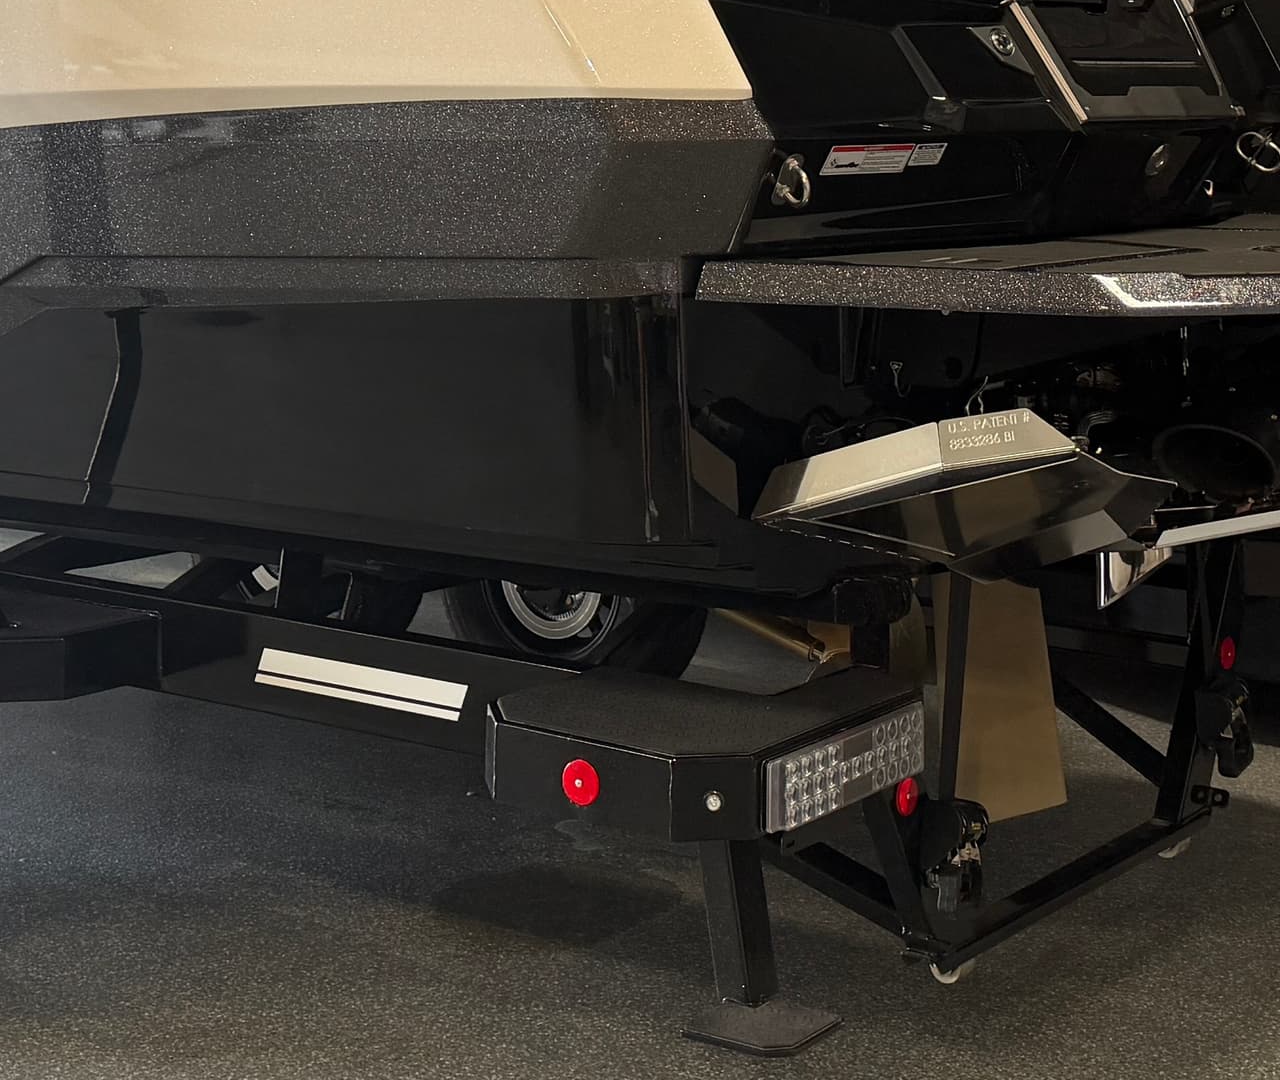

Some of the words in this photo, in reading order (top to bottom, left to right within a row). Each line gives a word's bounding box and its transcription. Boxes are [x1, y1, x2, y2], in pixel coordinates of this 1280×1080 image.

[947, 420, 970, 433] U.S.
[973, 413, 1018, 430] PATENT
[949, 432, 1001, 450] 8833286
